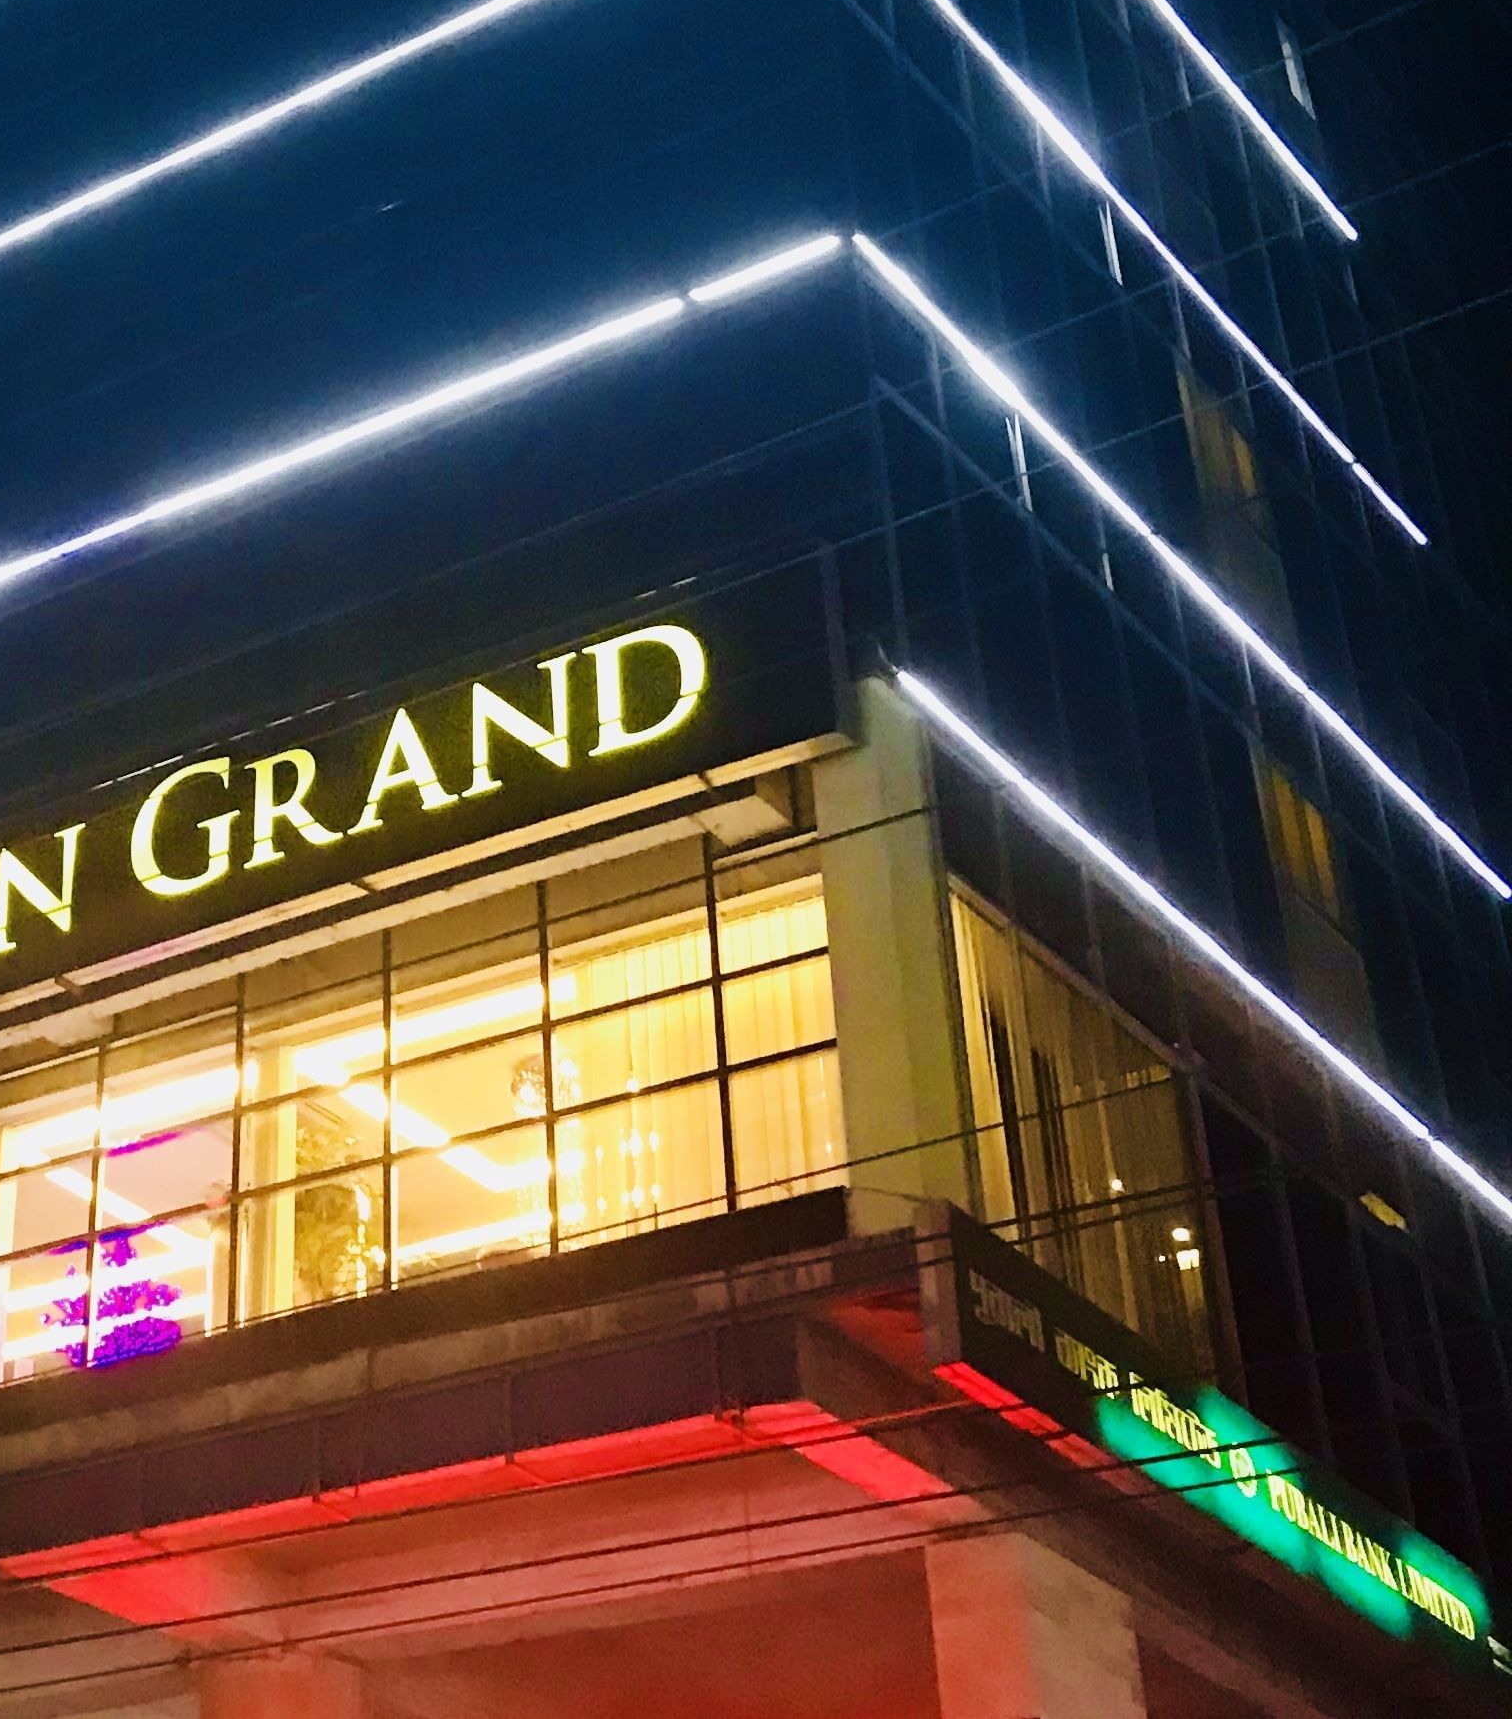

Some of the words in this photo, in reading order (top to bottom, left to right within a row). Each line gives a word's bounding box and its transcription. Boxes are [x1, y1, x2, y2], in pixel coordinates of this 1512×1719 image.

[131, 625, 706, 896] GRAND
[1266, 1467, 1343, 1554] PUBALI
[1340, 1520, 1398, 1590] BANK
[1395, 1558, 1476, 1640] LIMITED
